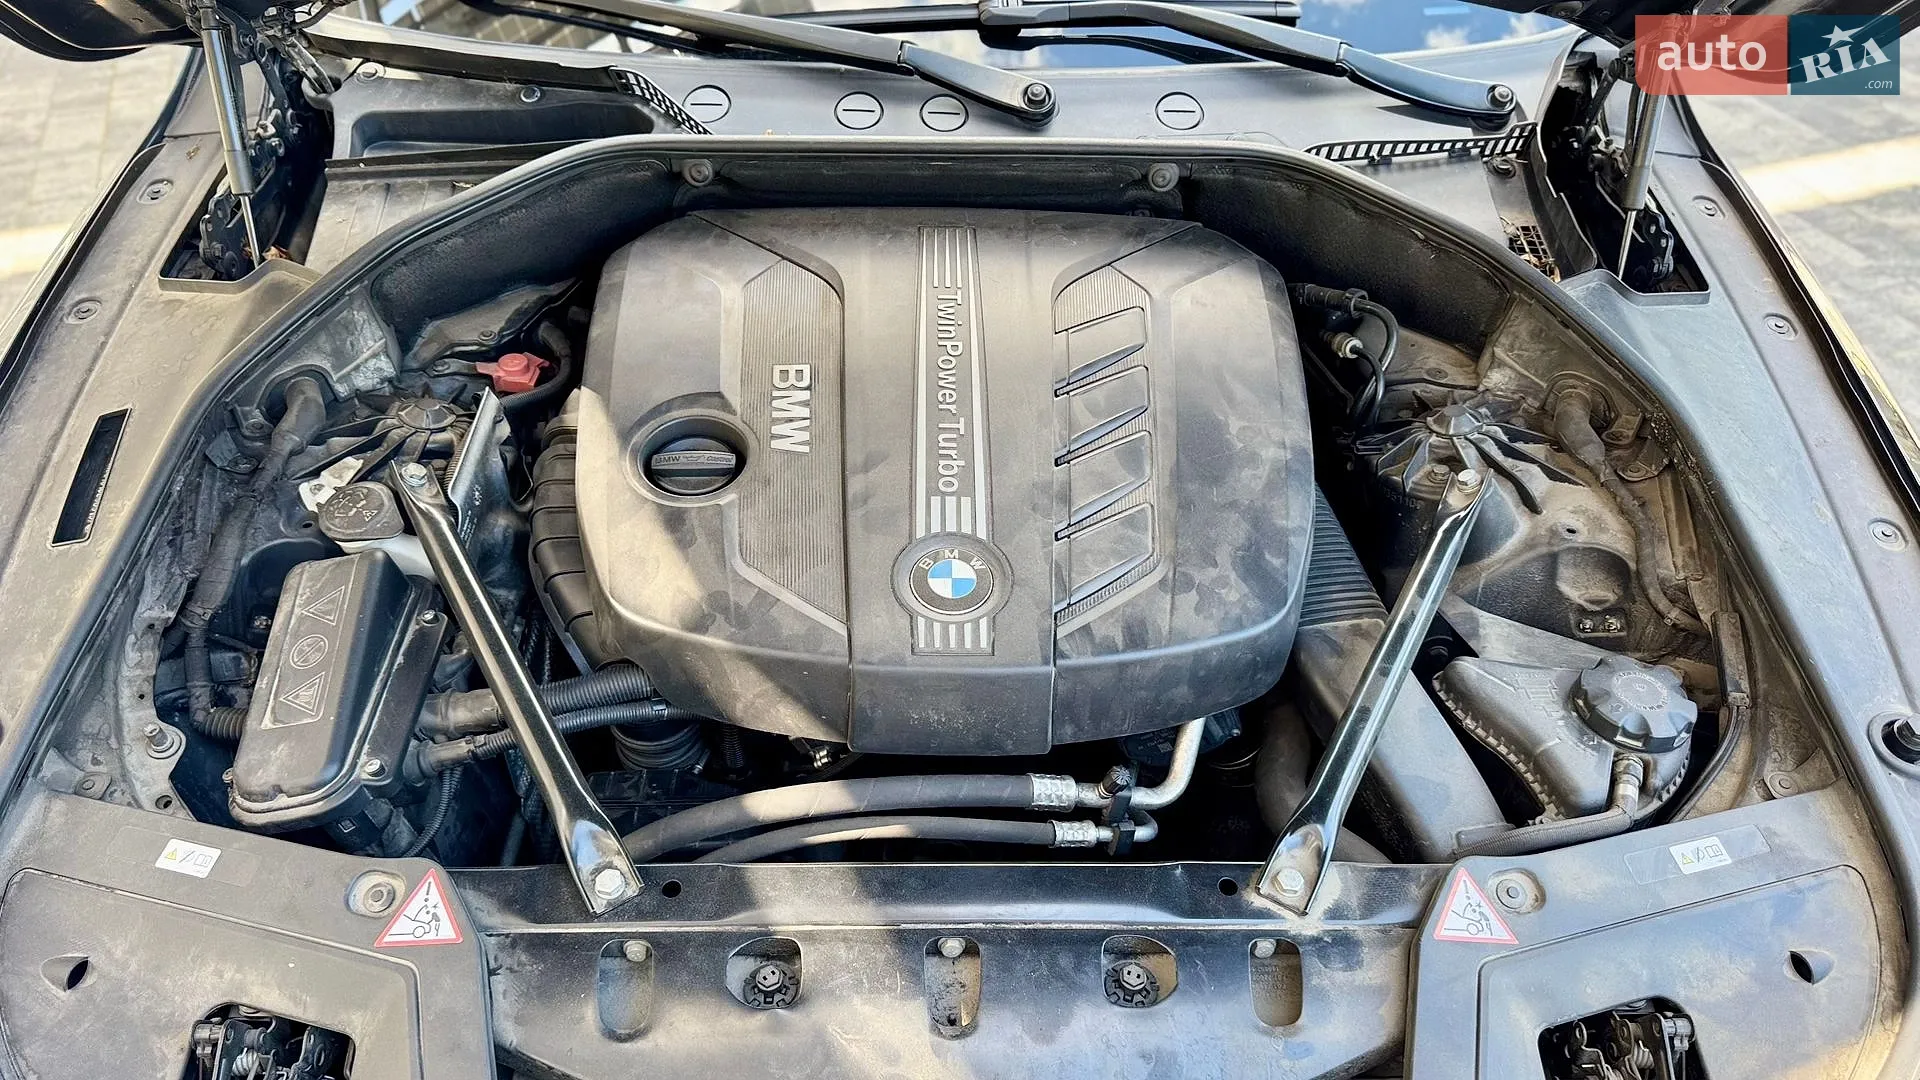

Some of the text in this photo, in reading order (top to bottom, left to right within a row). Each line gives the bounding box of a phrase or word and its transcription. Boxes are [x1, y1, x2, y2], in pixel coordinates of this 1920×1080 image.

[770, 364, 811, 453] BMW
[936, 289, 966, 493] TwinPower Turbo
[918, 549, 987, 570] BMW
